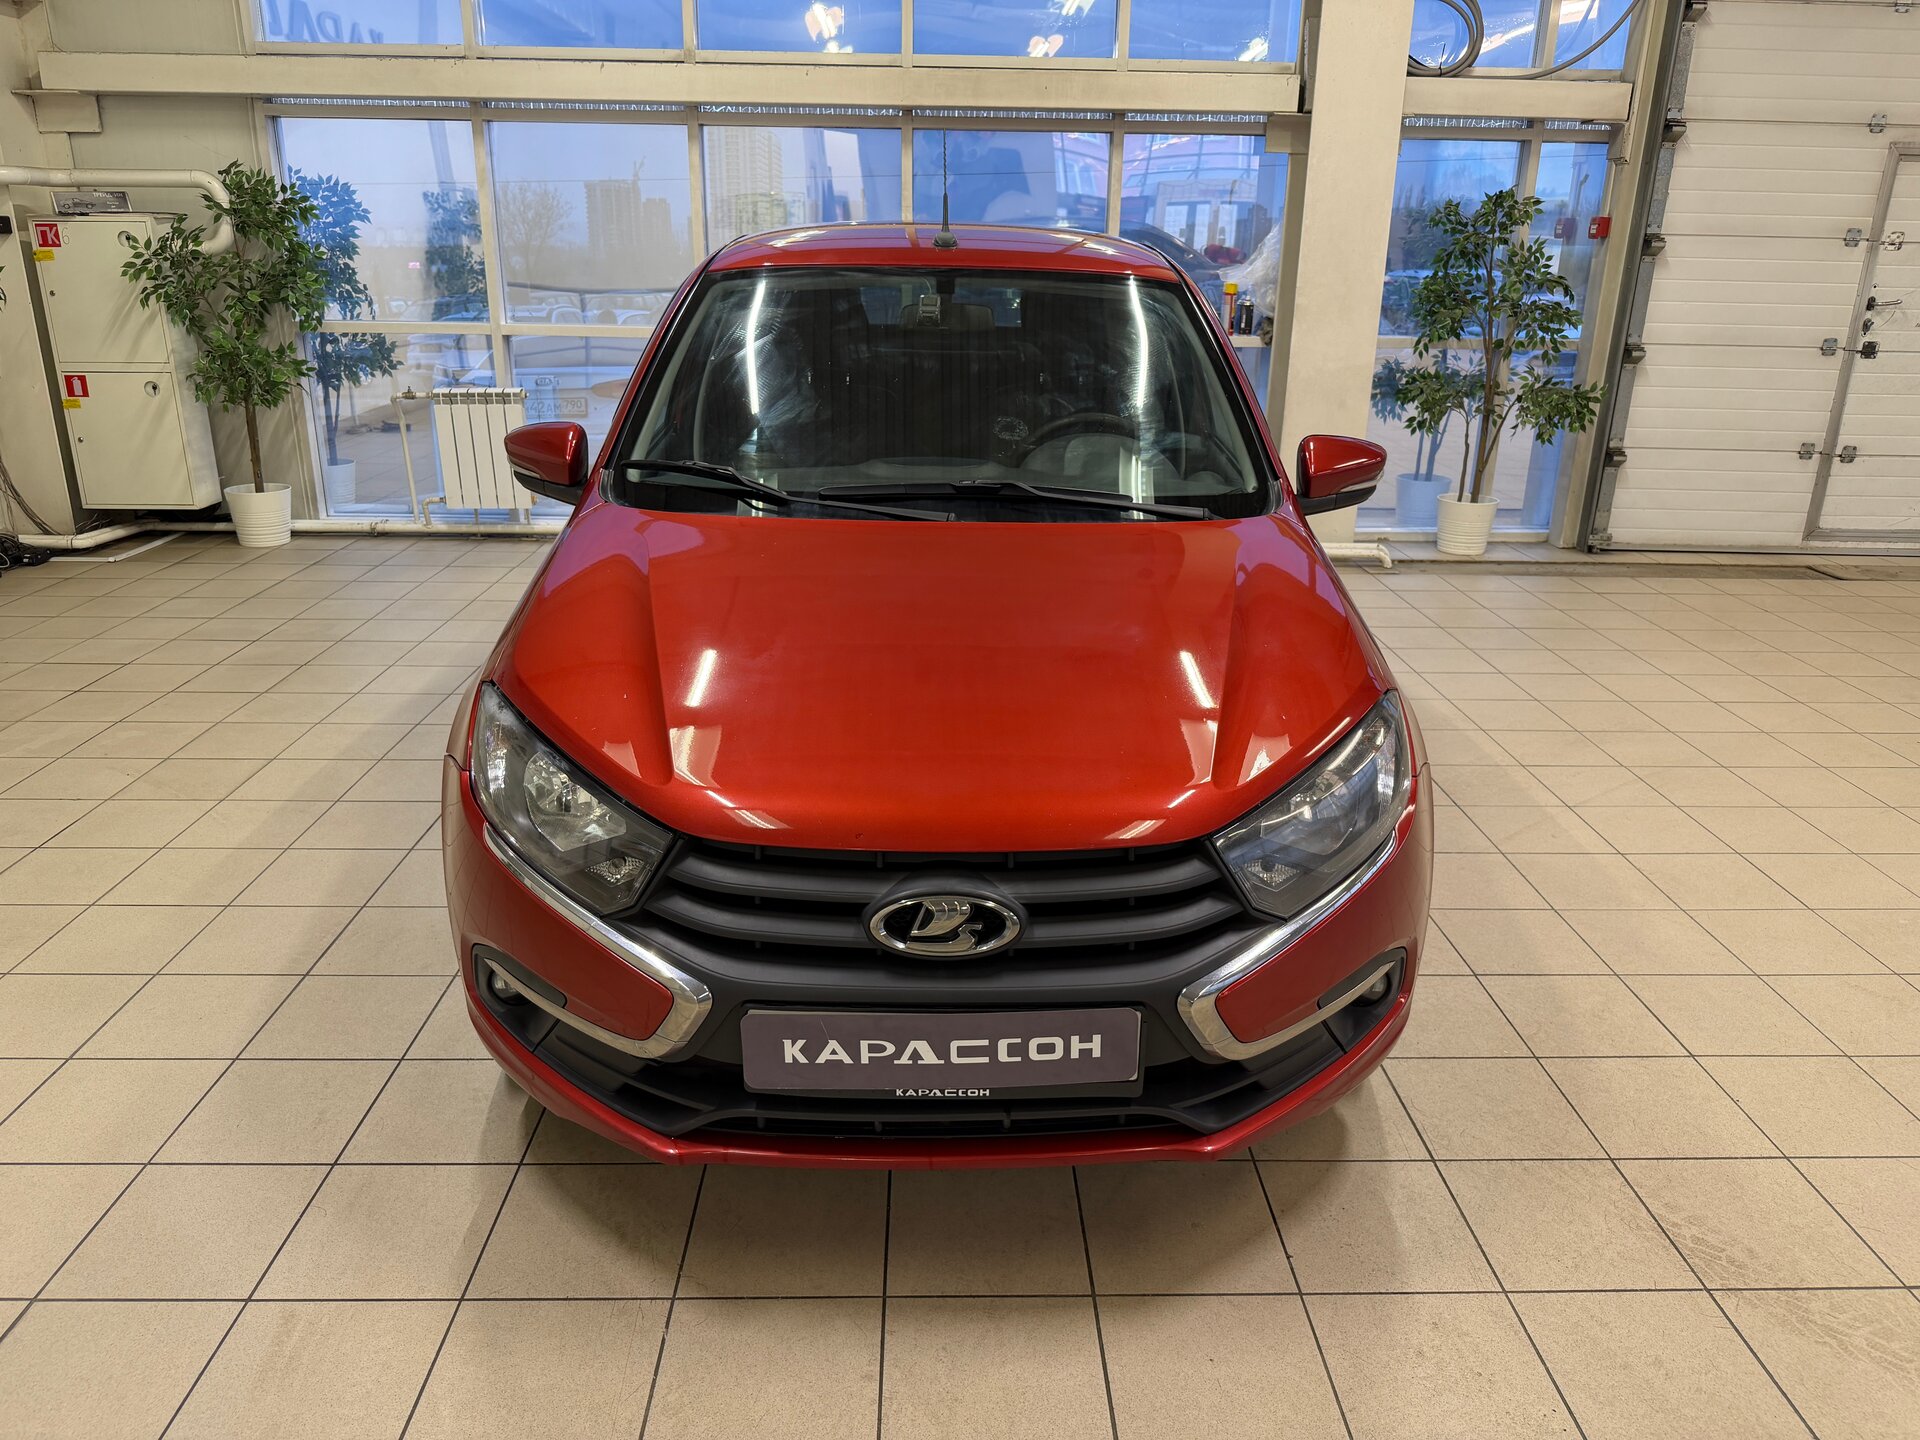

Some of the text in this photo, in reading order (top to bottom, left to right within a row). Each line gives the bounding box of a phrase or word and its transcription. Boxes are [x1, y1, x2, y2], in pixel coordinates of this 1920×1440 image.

[36, 226, 60, 244] ПК
[782, 1034, 1102, 1065] КАРАССОН
[896, 1088, 990, 1097] КАРАССОН
